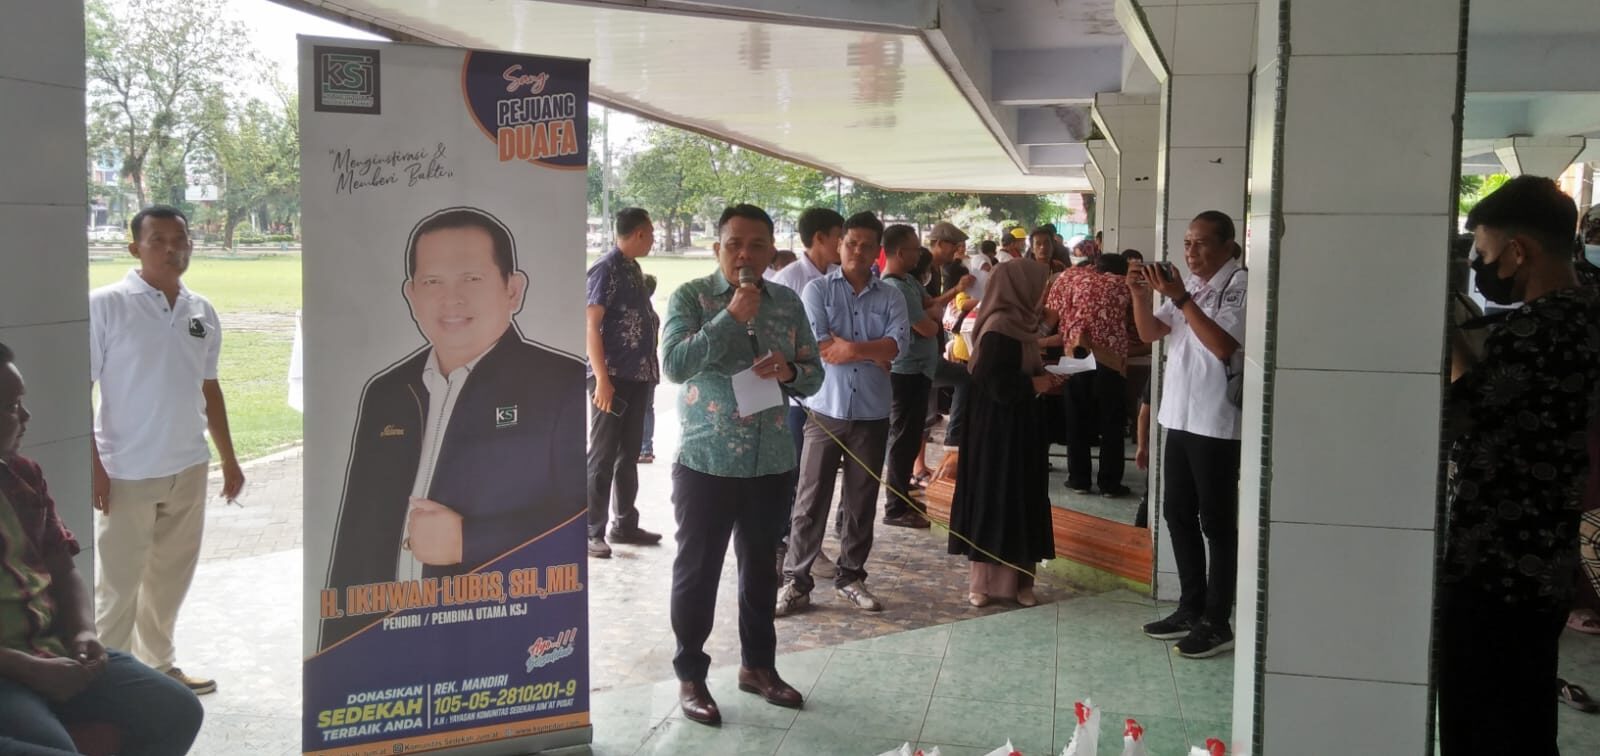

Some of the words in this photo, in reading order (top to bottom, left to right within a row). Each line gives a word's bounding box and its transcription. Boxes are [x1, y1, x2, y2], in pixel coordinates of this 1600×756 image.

[503, 64, 549, 94] Sang
[497, 93, 576, 126] PEJUANG
[433, 143, 447, 158] &
[498, 119, 578, 162] DUAFA
[336, 167, 398, 194] Memberi
[320, 588, 343, 618] H.
[346, 577, 438, 616] IKHWAN
[442, 570, 508, 604] LUBIS,
[383, 616, 421, 631] PENDIRI
[423, 613, 430, 627] /
[432, 609, 474, 626] PEMBINA
[476, 605, 507, 620] UTAMA
[510, 602, 528, 617] KSJ
[347, 685, 423, 705] DONASIKAN
[433, 681, 458, 695] REK.
[462, 674, 508, 692] MANDIRI
[433, 680, 576, 715] 105-05-2810201-9
[317, 698, 423, 728] SEDEKAH
[323, 723, 381, 741] TERBAIK
[384, 717, 423, 733] ANDA
